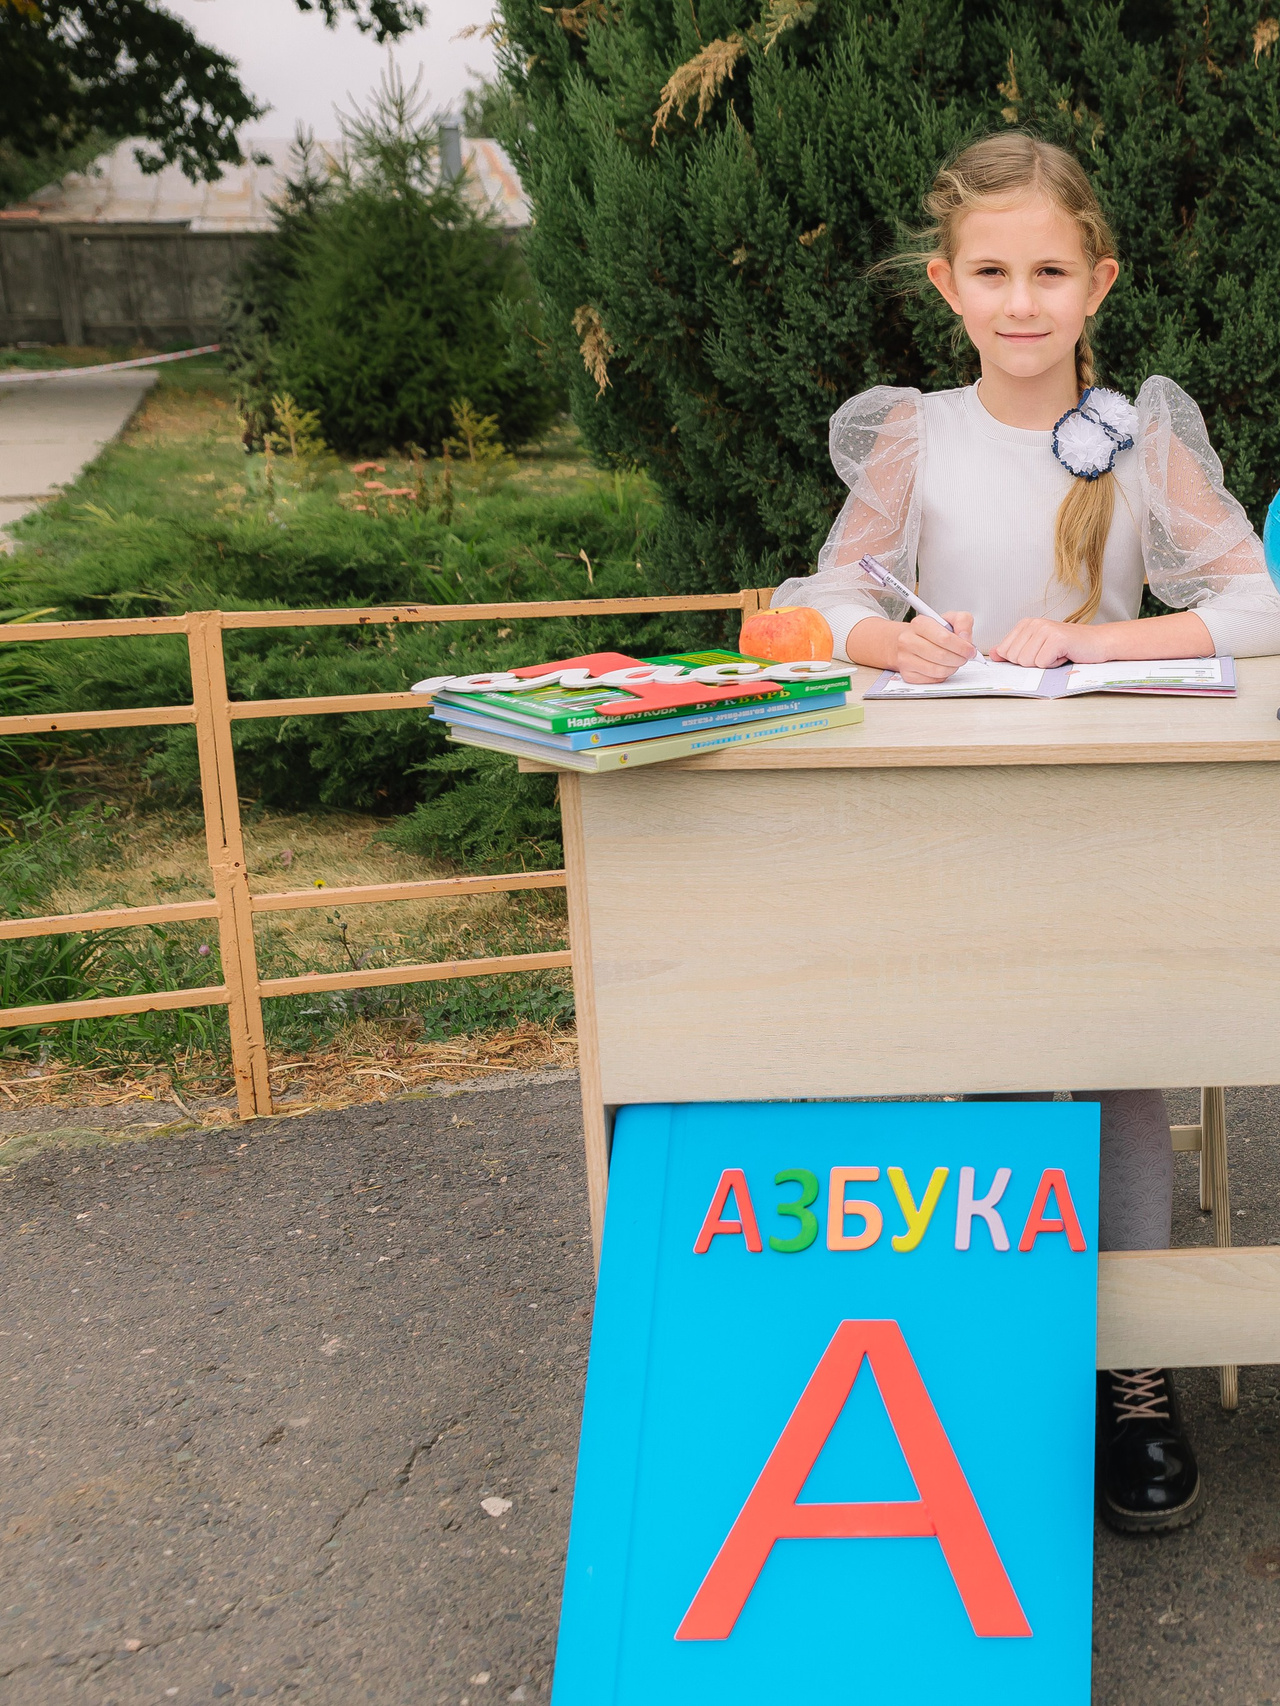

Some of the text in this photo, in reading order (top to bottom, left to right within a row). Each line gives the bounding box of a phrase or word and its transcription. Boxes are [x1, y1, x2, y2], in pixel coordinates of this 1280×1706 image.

[567, 714, 621, 728] Надежда
[681, 701, 801, 727] Лучшие волшебные сказки
[753, 725, 790, 738] принцах
[799, 719, 829, 730] Сказки
[690, 732, 743, 750] принцессах
[693, 1166, 1088, 1254] АЗБУКА
[673, 1318, 1034, 1642] А
